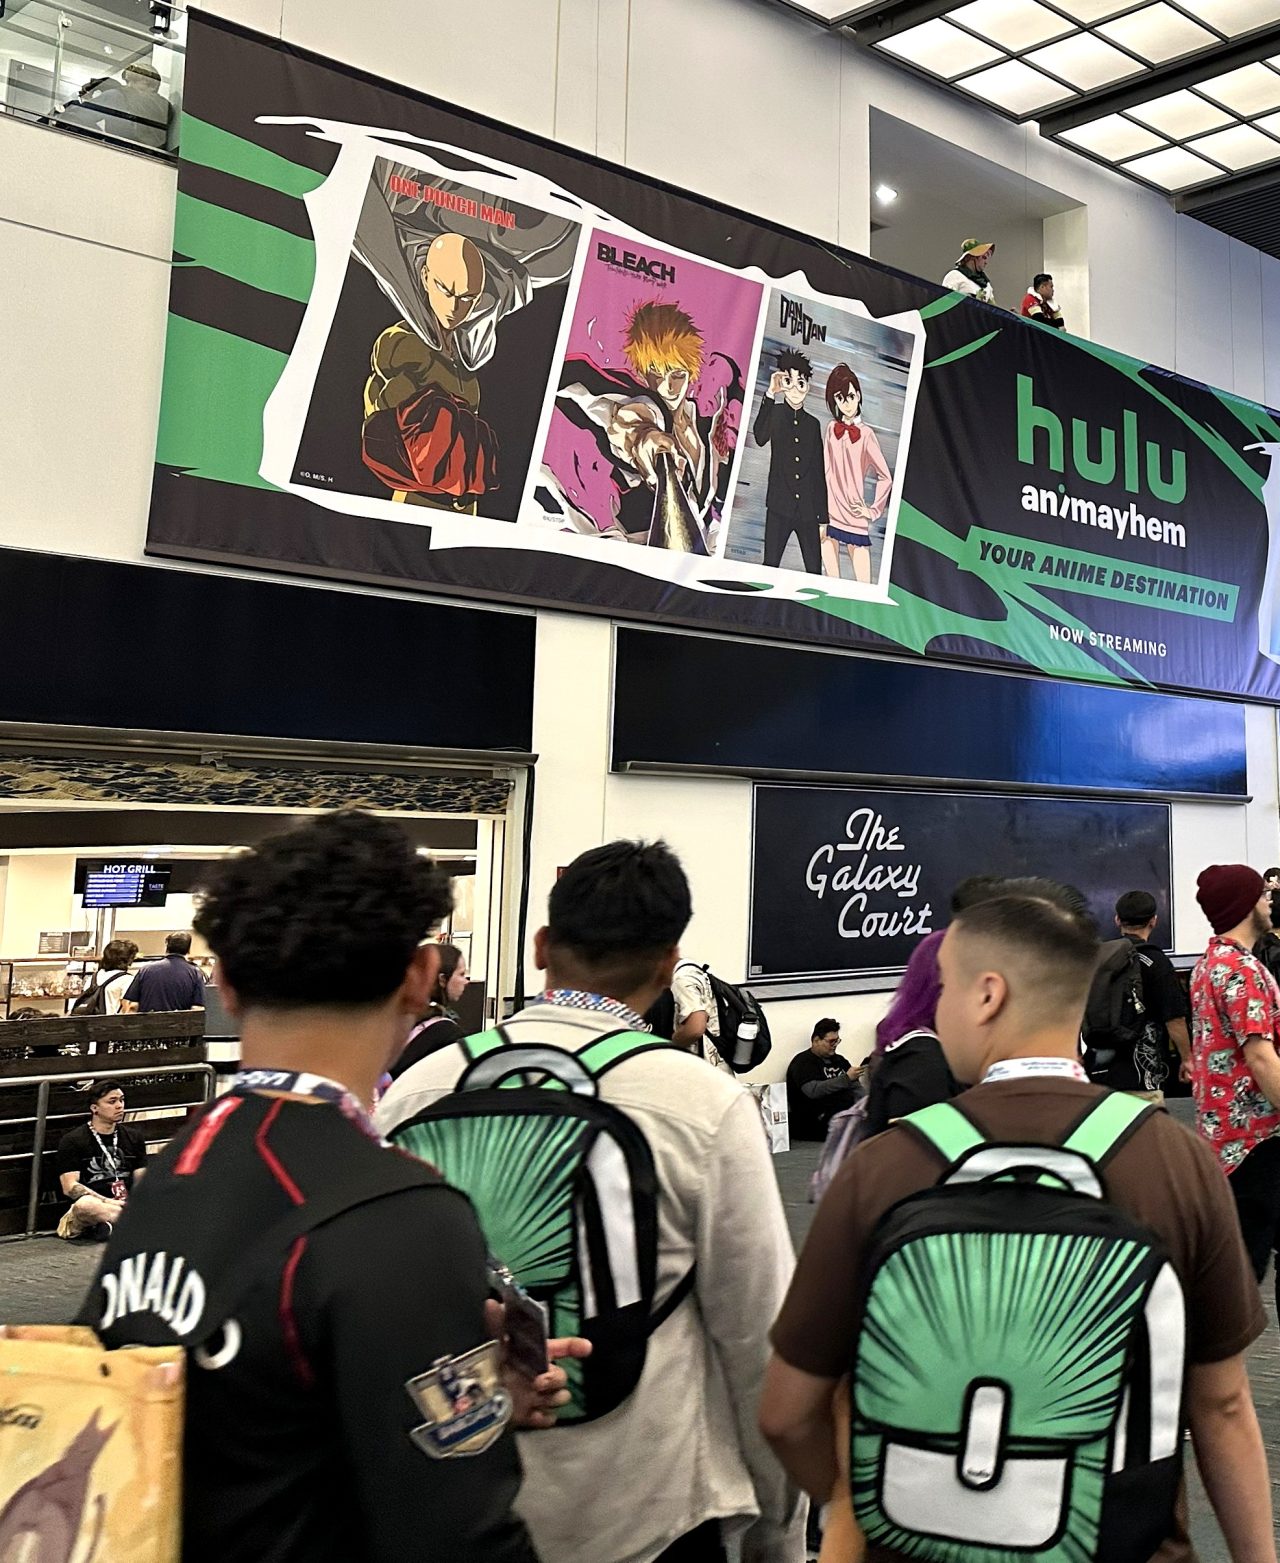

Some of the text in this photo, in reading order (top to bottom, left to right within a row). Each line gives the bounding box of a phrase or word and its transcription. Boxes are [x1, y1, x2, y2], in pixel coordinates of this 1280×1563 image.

[389, 174, 517, 230] ONE PUNCH MAN
[597, 242, 676, 284] BLEACH
[1016, 373, 1187, 505] hulu
[1021, 483, 1187, 548] animayhem
[979, 540, 1230, 612] YOUR ANIME DESTINATION
[1050, 624, 1167, 658] NOW STREAMING
[836, 807, 905, 851] The
[103, 864, 157, 874] HOT GRILL
[805, 844, 921, 899] Galaxy
[837, 892, 933, 938] Court
